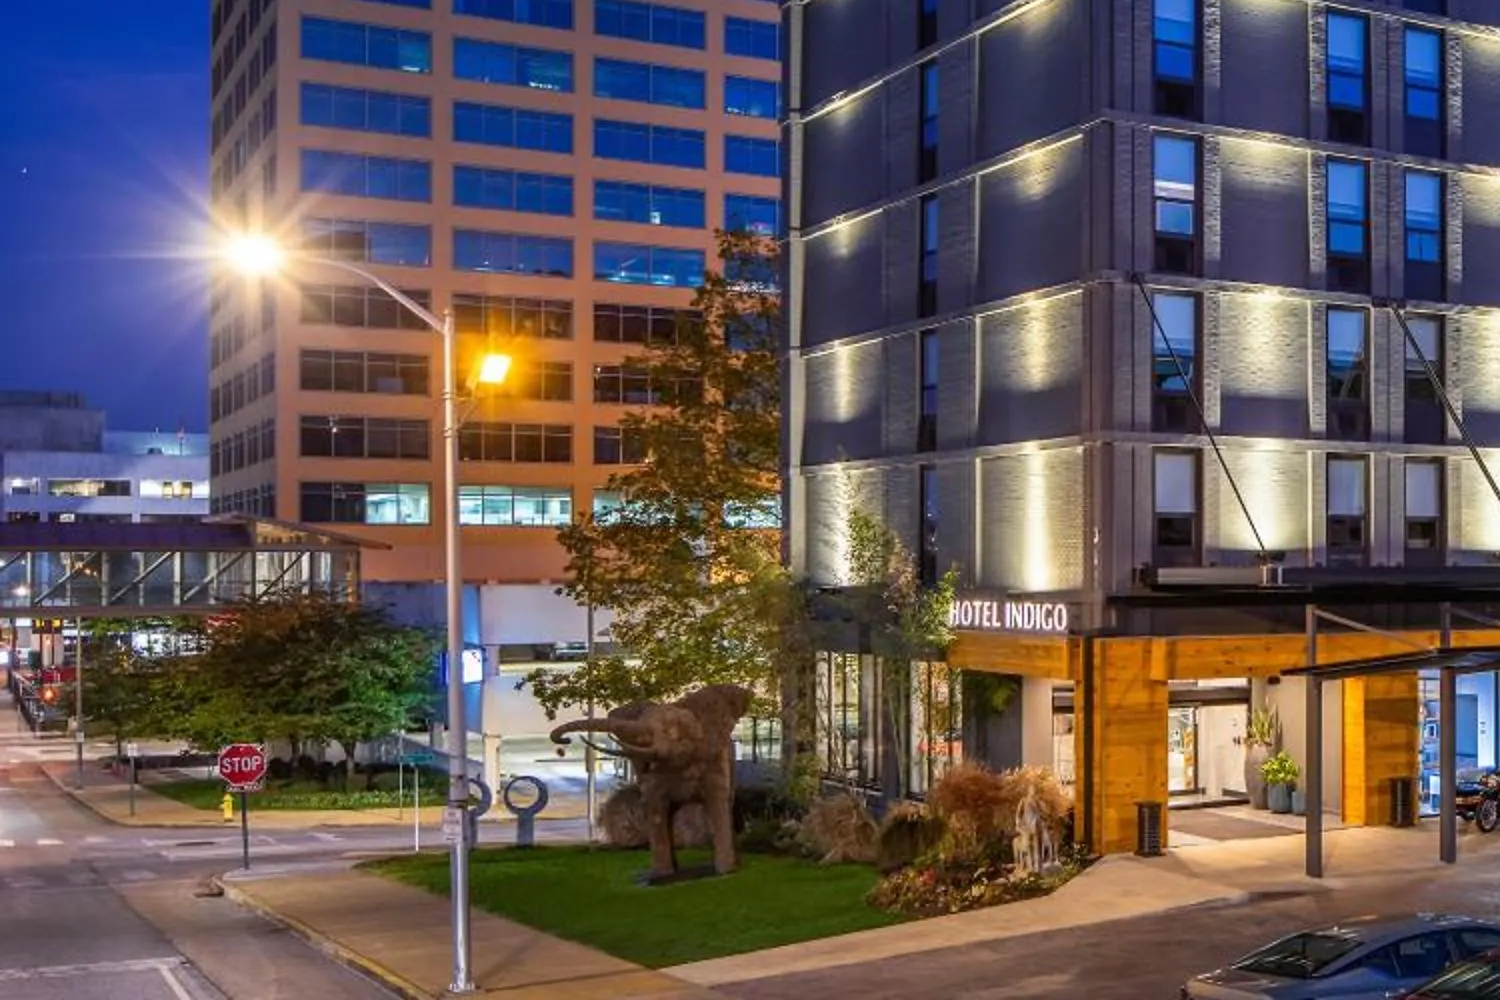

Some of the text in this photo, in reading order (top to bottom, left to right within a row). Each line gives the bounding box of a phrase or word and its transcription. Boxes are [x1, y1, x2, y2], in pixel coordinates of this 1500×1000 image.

[949, 600, 1067, 630] HOTEL INDIGO
[221, 755, 262, 773] STOP
